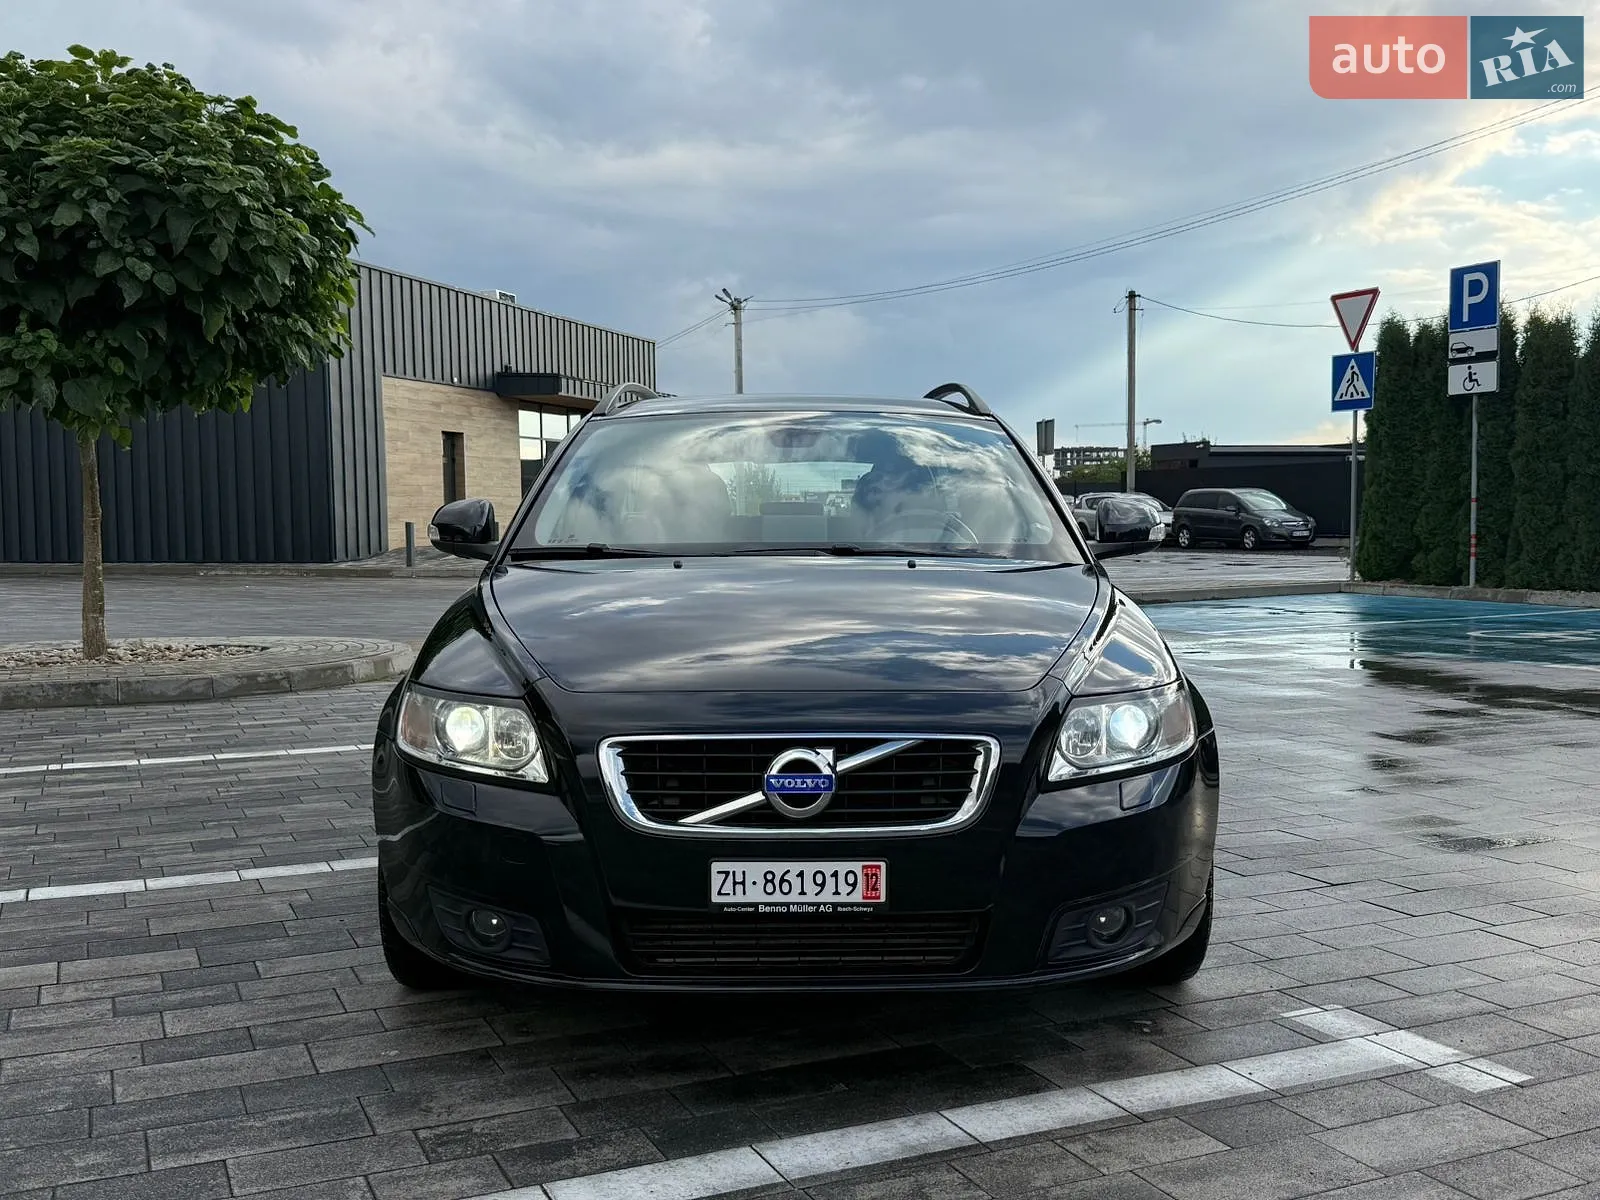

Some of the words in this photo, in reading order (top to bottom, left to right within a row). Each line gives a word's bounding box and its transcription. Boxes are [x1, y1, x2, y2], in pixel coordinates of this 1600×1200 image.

[1462, 272, 1489, 322] P
[769, 778, 830, 788] VOLVO
[758, 904, 788, 913] Benno
[789, 904, 817, 913] Müller
[819, 904, 833, 913] AG
